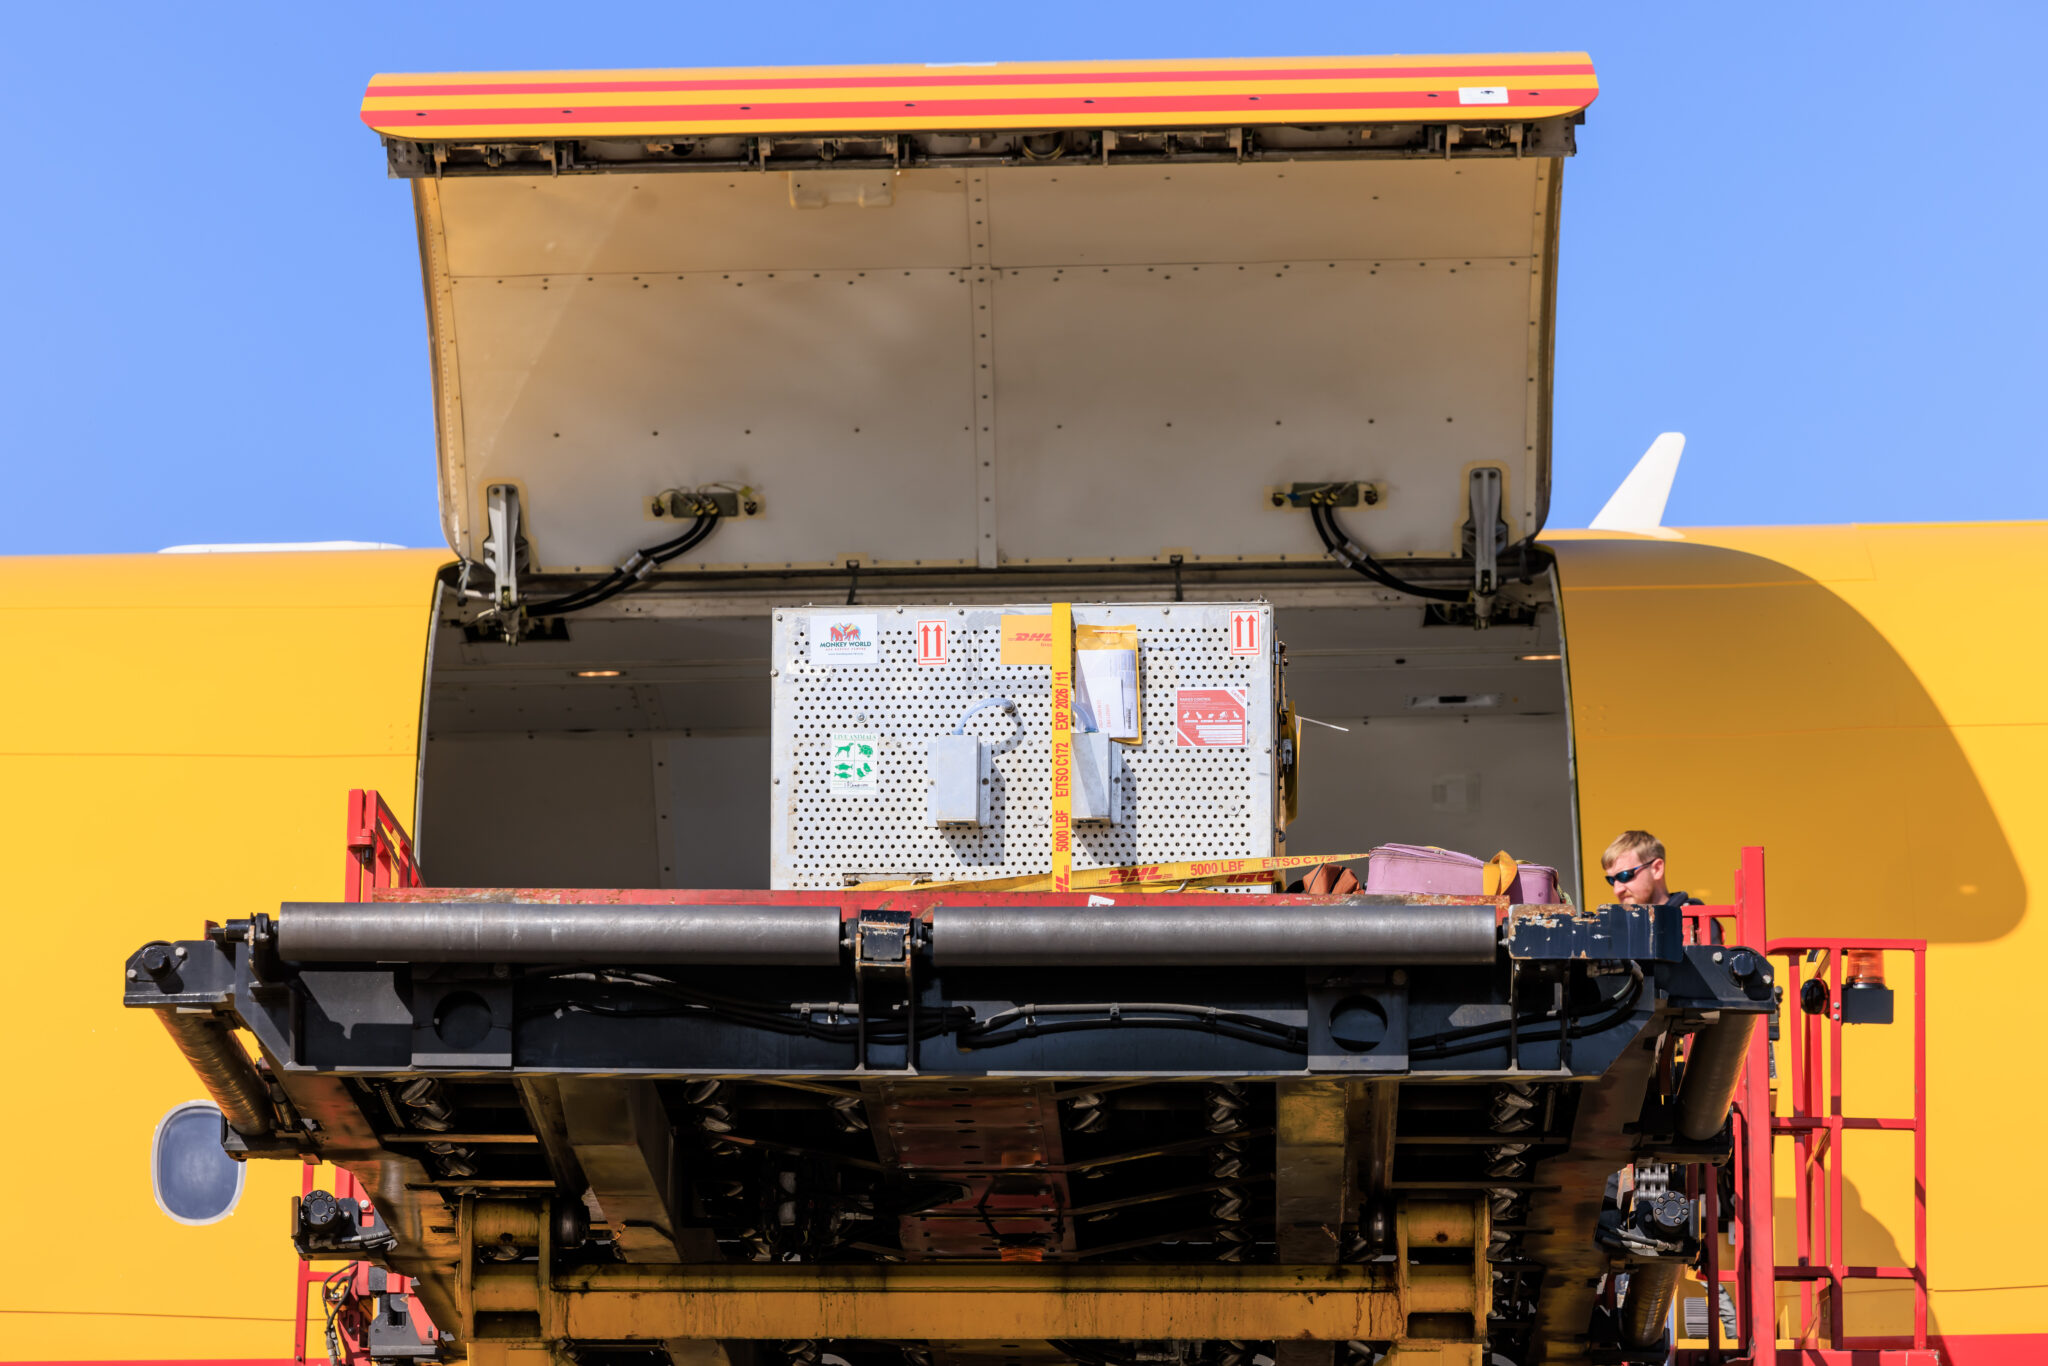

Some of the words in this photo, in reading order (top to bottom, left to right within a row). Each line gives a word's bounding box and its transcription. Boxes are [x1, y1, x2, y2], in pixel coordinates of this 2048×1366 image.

[1015, 633, 1052, 641] DHL
[1055, 711, 1069, 730] EXP
[1055, 742, 1069, 766] C172
[1055, 767, 1069, 797] E/TSO
[1055, 810, 1069, 828] LBF
[1055, 830, 1069, 852] 5000
[1109, 867, 1163, 884] DHL
[1190, 862, 1218, 876] 5000
[1220, 860, 1245, 873] LBF
